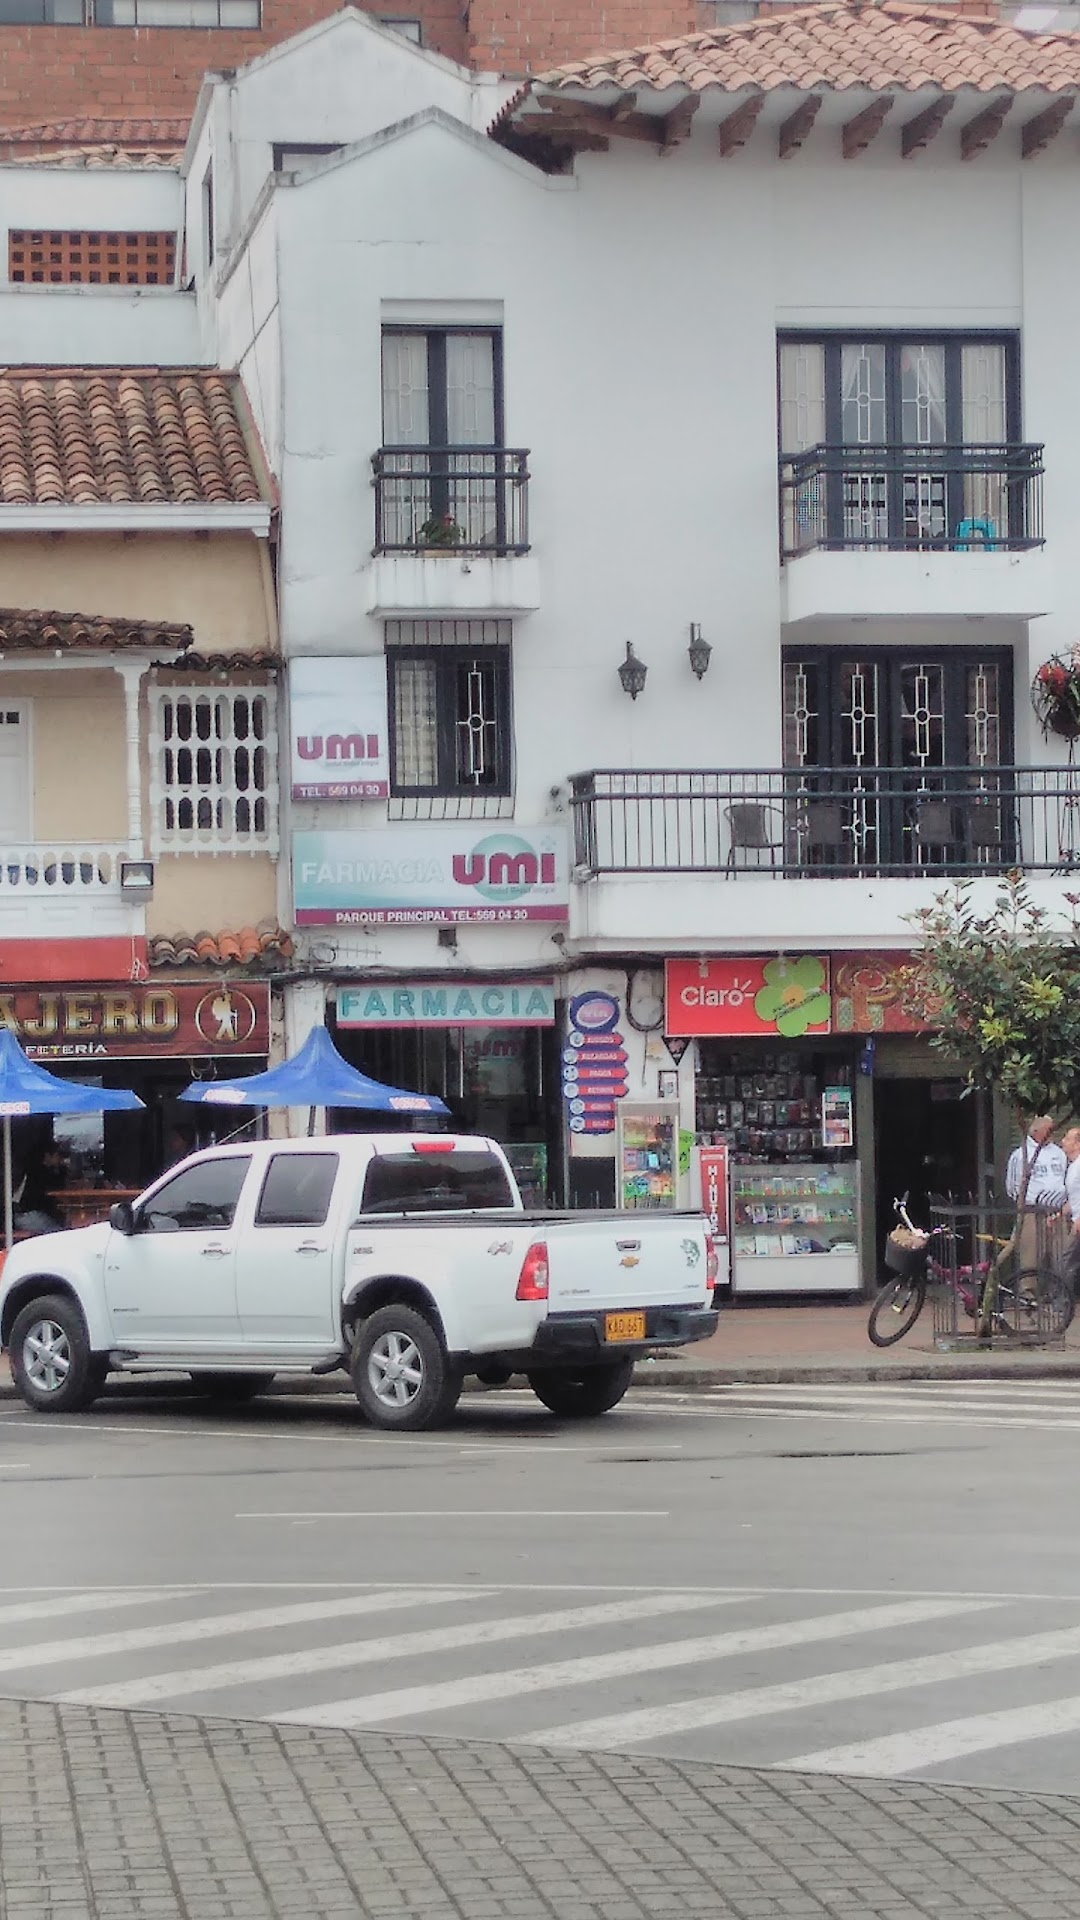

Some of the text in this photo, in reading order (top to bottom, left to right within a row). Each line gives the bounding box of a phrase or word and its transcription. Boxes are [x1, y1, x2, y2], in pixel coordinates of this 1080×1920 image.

[301, 861, 444, 884] FARMACIA
[336, 911, 385, 923] PARQUE
[387, 910, 449, 922] PRINCIPAL
[498, 910, 512, 920] 04
[341, 988, 550, 1017] FARMACIA
[680, 985, 744, 1007] Claro
[707, 1165, 719, 1234] MINUTOS
